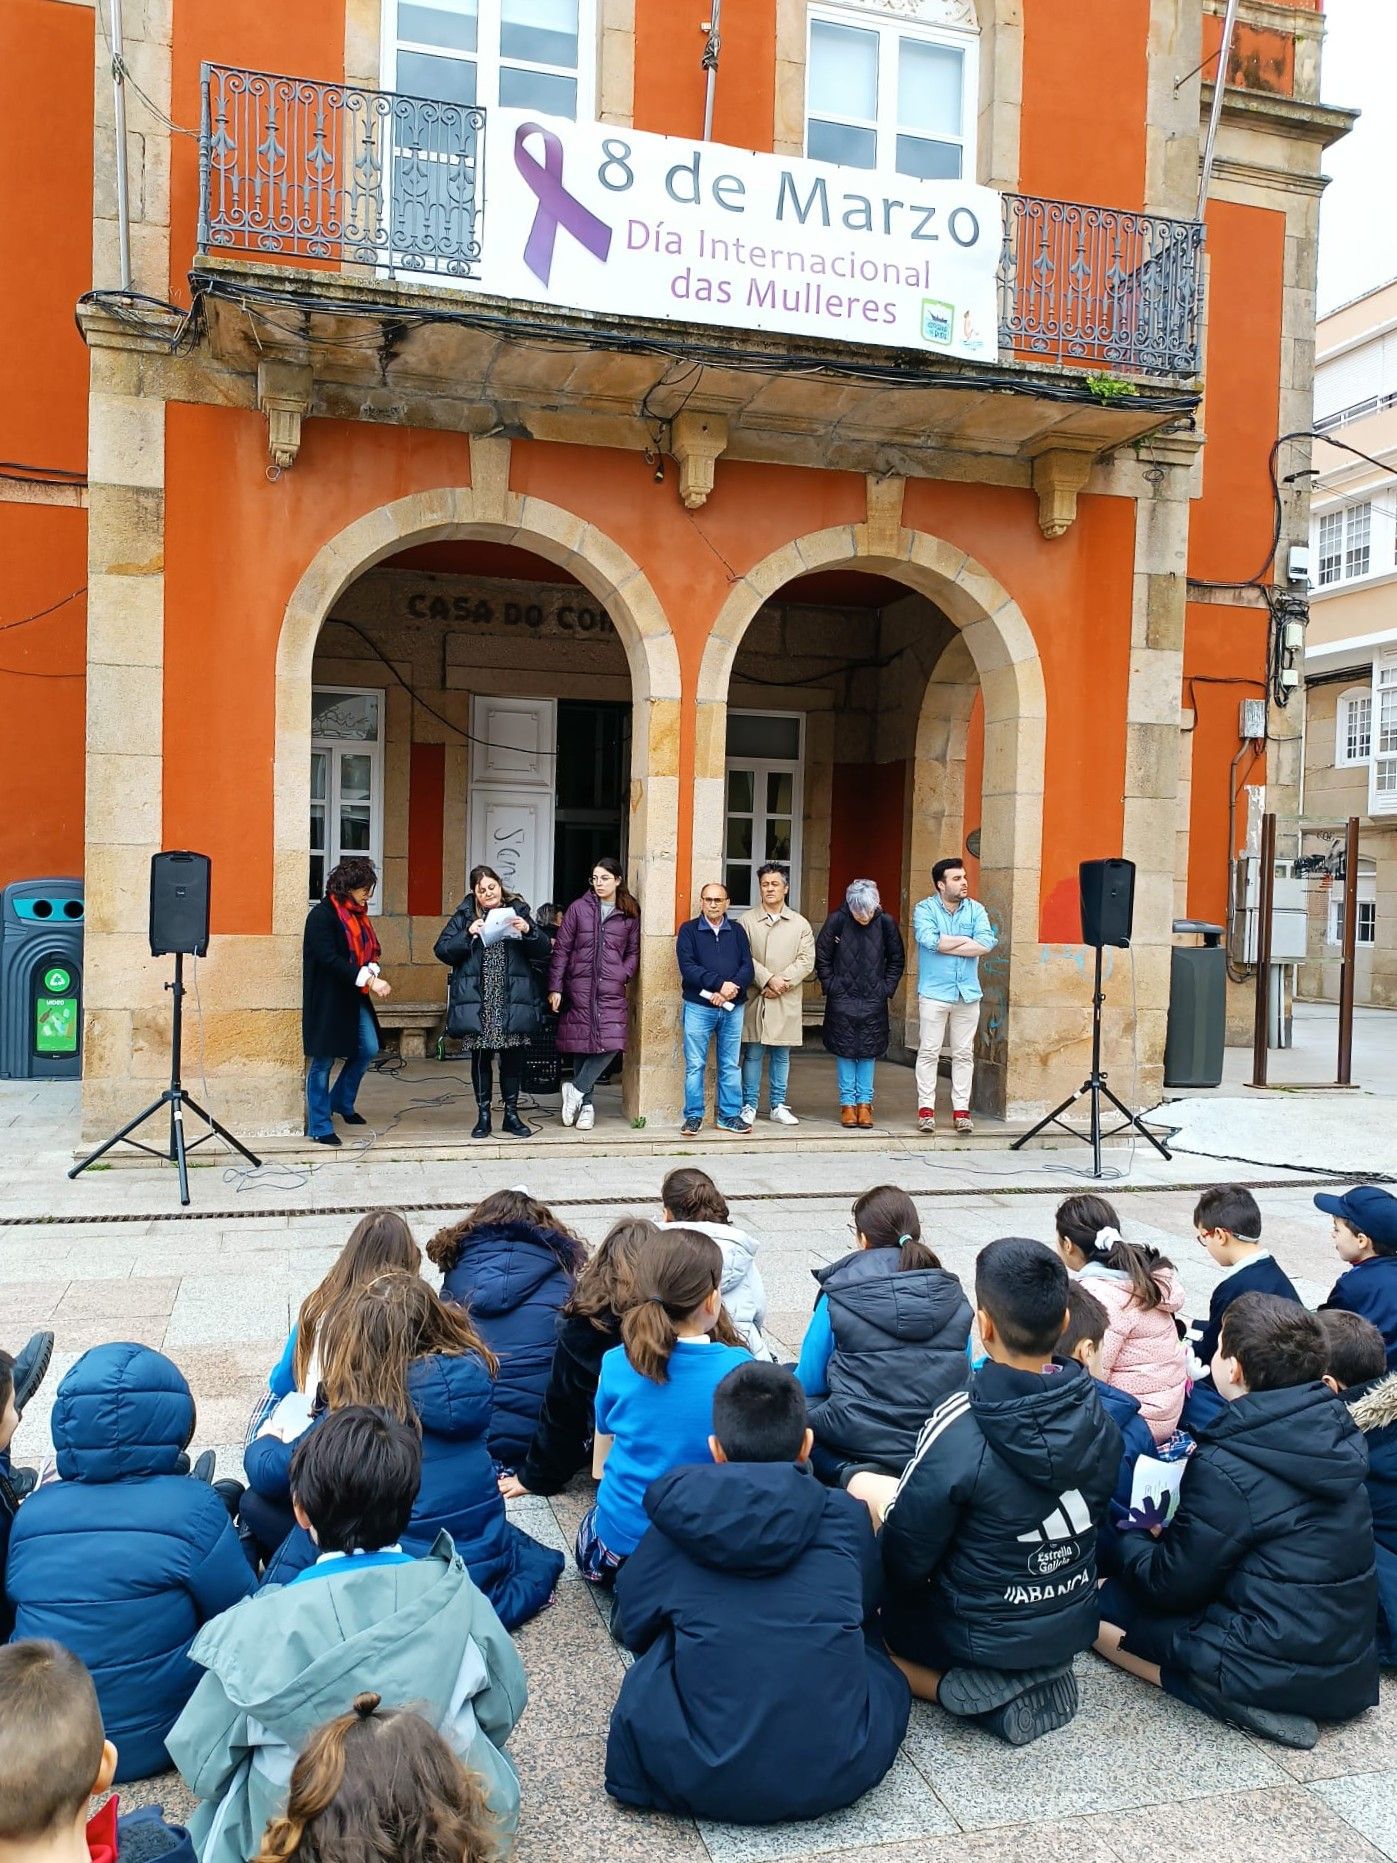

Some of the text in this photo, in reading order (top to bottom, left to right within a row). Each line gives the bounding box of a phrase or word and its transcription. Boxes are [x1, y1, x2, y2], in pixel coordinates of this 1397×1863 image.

[598, 139, 981, 247] 8 de Marzo
[627, 220, 931, 289] Día Internacional
[671, 268, 898, 325] das Mulleres
[408, 594, 492, 623] CASA
[504, 603, 543, 628] DO
[1038, 1546, 1072, 1562] Estrella
